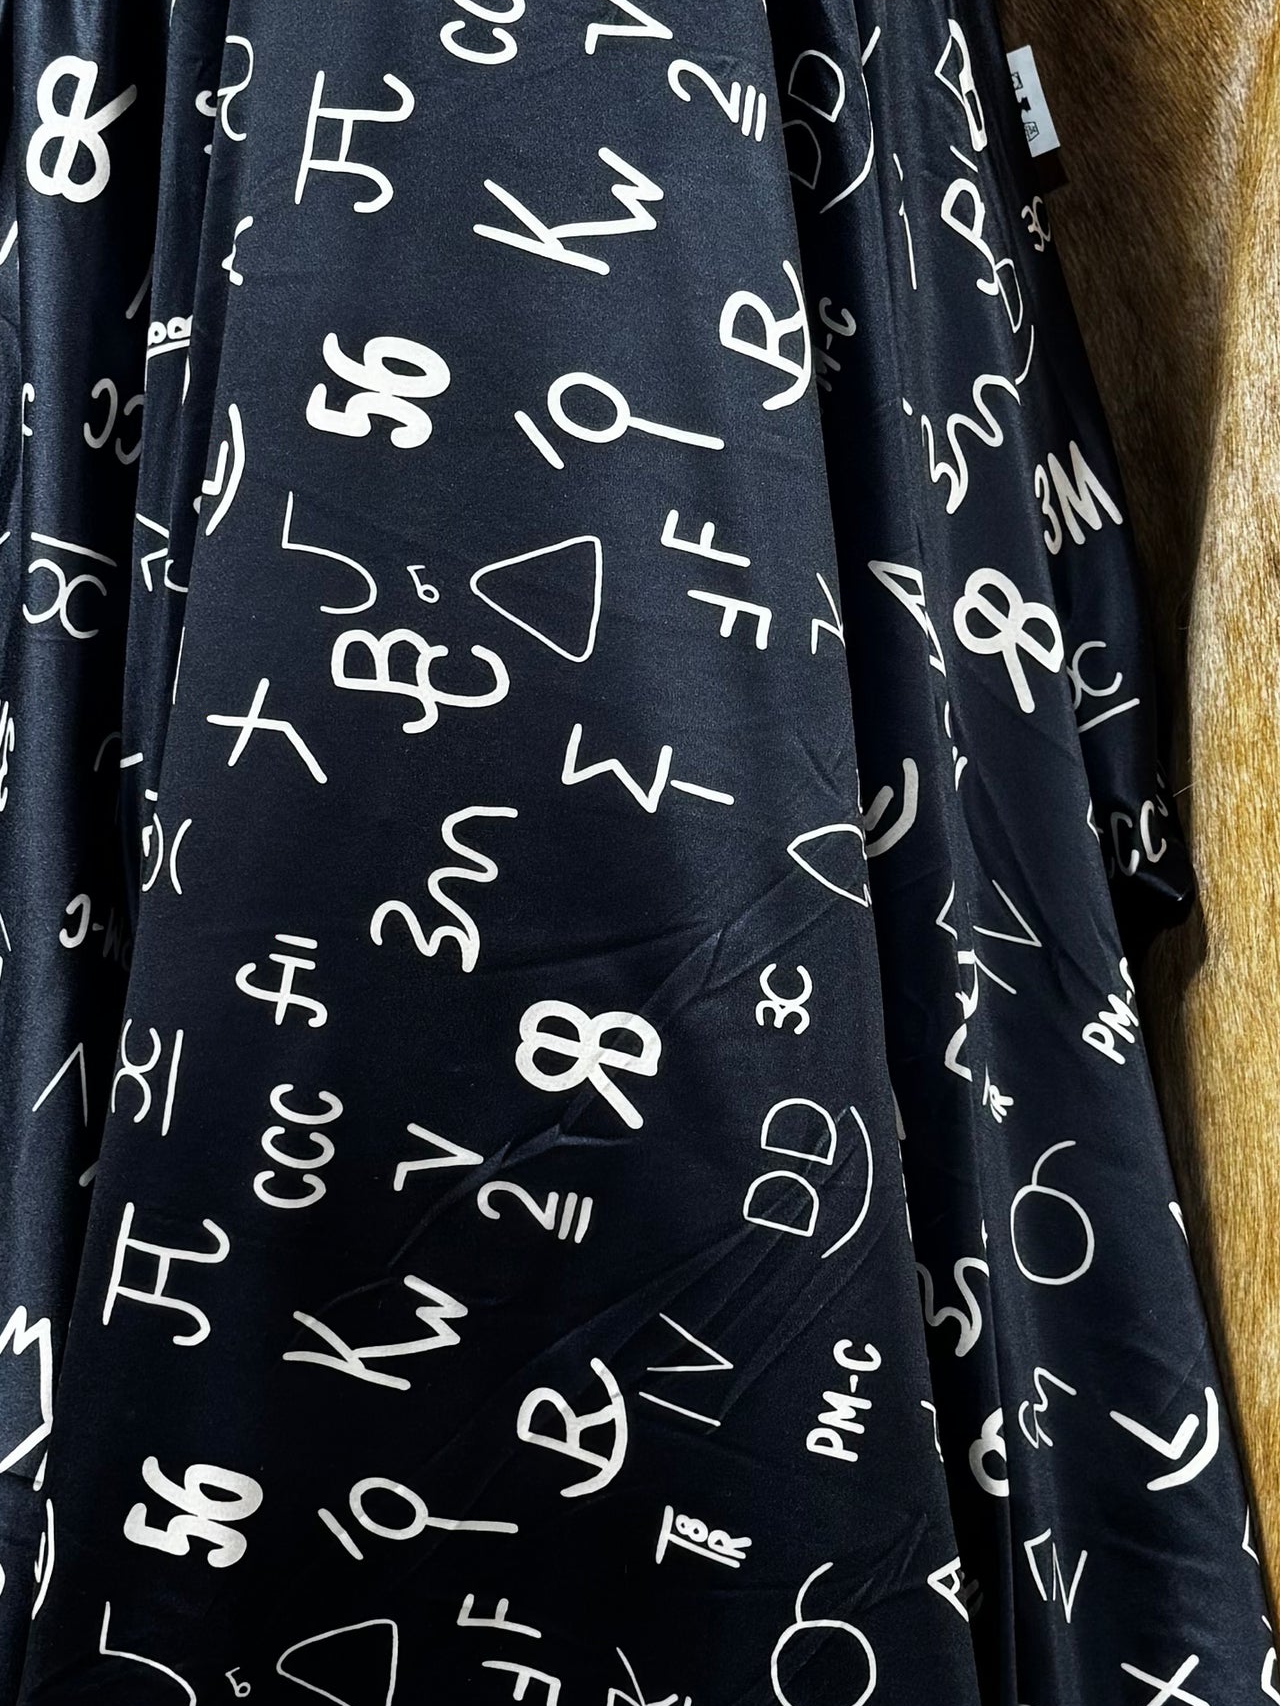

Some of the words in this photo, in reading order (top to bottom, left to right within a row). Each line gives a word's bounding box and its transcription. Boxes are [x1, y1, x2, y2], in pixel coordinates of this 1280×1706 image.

[306, 333, 450, 448] 56
[806, 1339, 881, 1462] PM-C
[124, 1456, 263, 1567] 56
